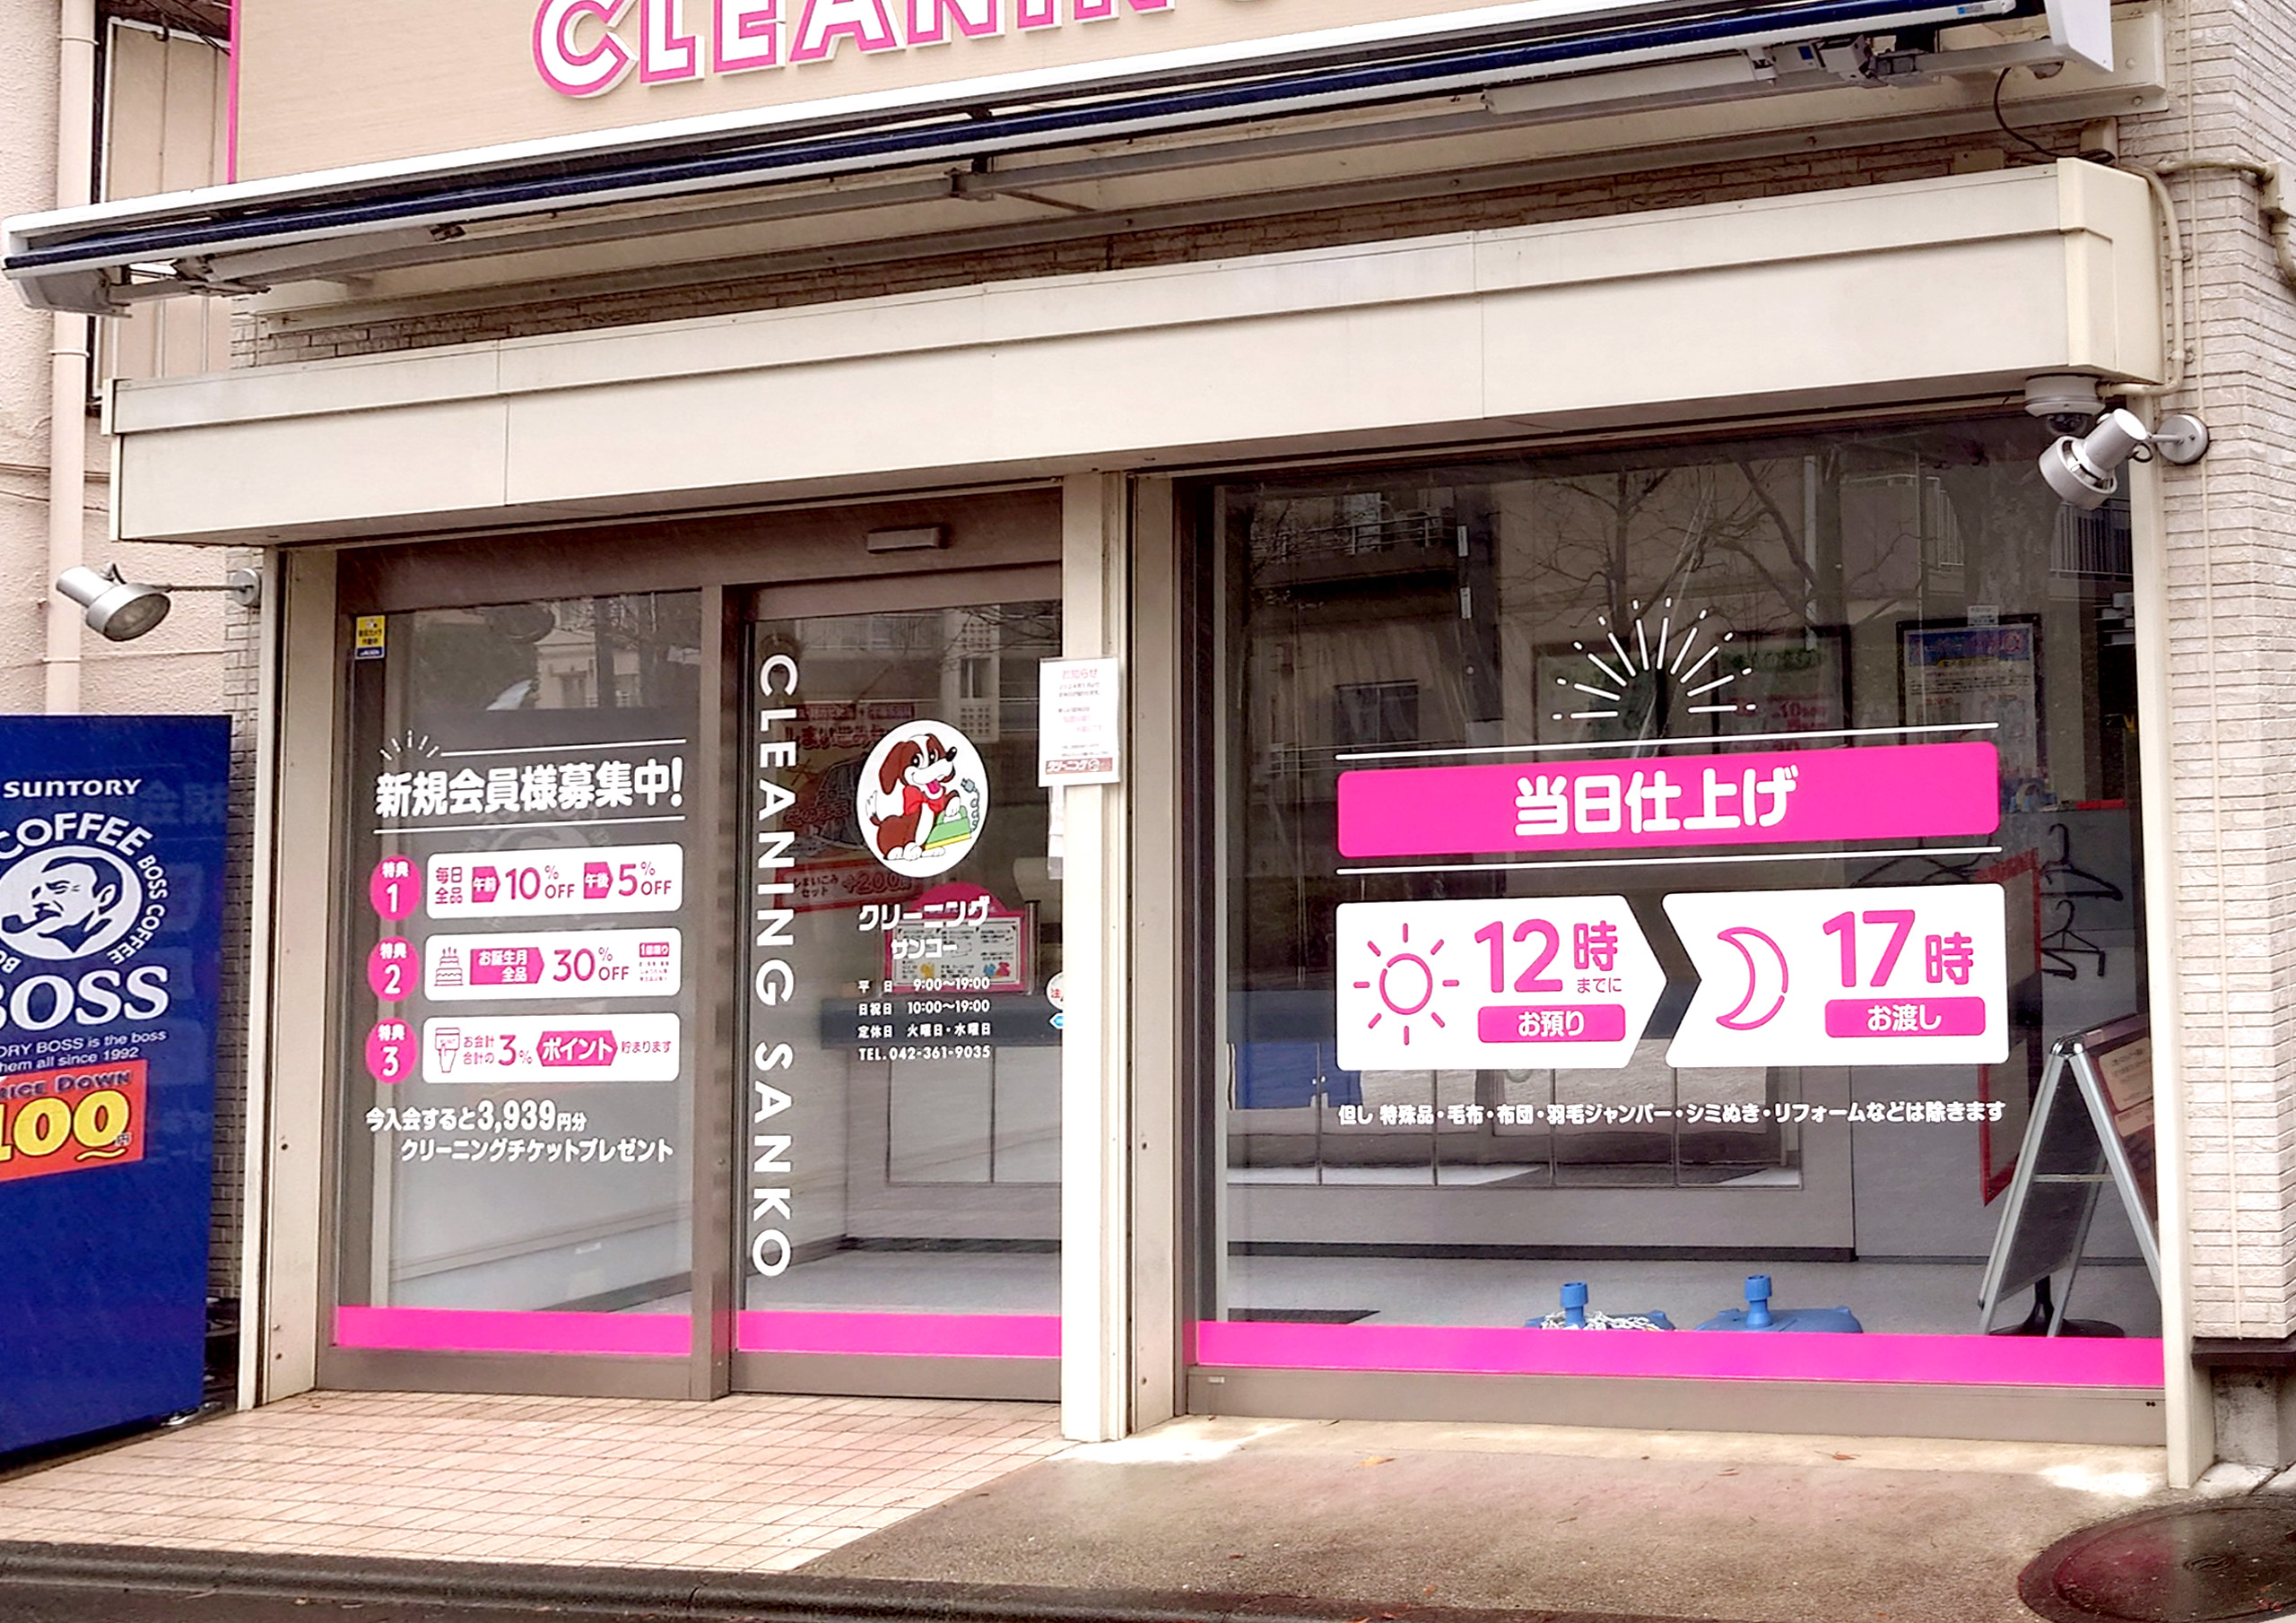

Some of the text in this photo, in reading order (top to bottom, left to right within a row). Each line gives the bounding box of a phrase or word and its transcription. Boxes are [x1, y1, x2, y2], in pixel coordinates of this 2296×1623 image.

[3, 779, 143, 798] SUNTORY
[1514, 763, 1799, 837] 当日仕上げ
[107, 855, 168, 965] BOSS COFFEE
[386, 883, 398, 913] 1
[858, 896, 991, 931] クリーニング
[891, 937, 958, 959] サンコー
[384, 964, 402, 994] 2
[752, 655, 799, 1277] CLEANING SANKO
[0, 964, 170, 1031] OSS
[1576, 976, 1623, 994] までに
[857, 1002, 892, 1016] 日祝日
[1866, 1002, 1943, 1032] お渡し
[857, 1024, 893, 1038] 定休日
[1517, 1010, 1585, 1038] お預り
[36, 1037, 84, 1054] BOSS
[89, 1036, 100, 1048] is
[104, 1033, 127, 1047] the
[131, 1030, 167, 1044] boss
[541, 1037, 613, 1062] ポイント
[621, 1039, 672, 1055] 貯まります
[36, 1055, 55, 1069] all
[57, 1053, 98, 1067] since
[103, 1046, 140, 1062] 1992
[382, 1046, 400, 1076] 3
[401, 1138, 674, 1162] クリーニングチケットプレゼント
